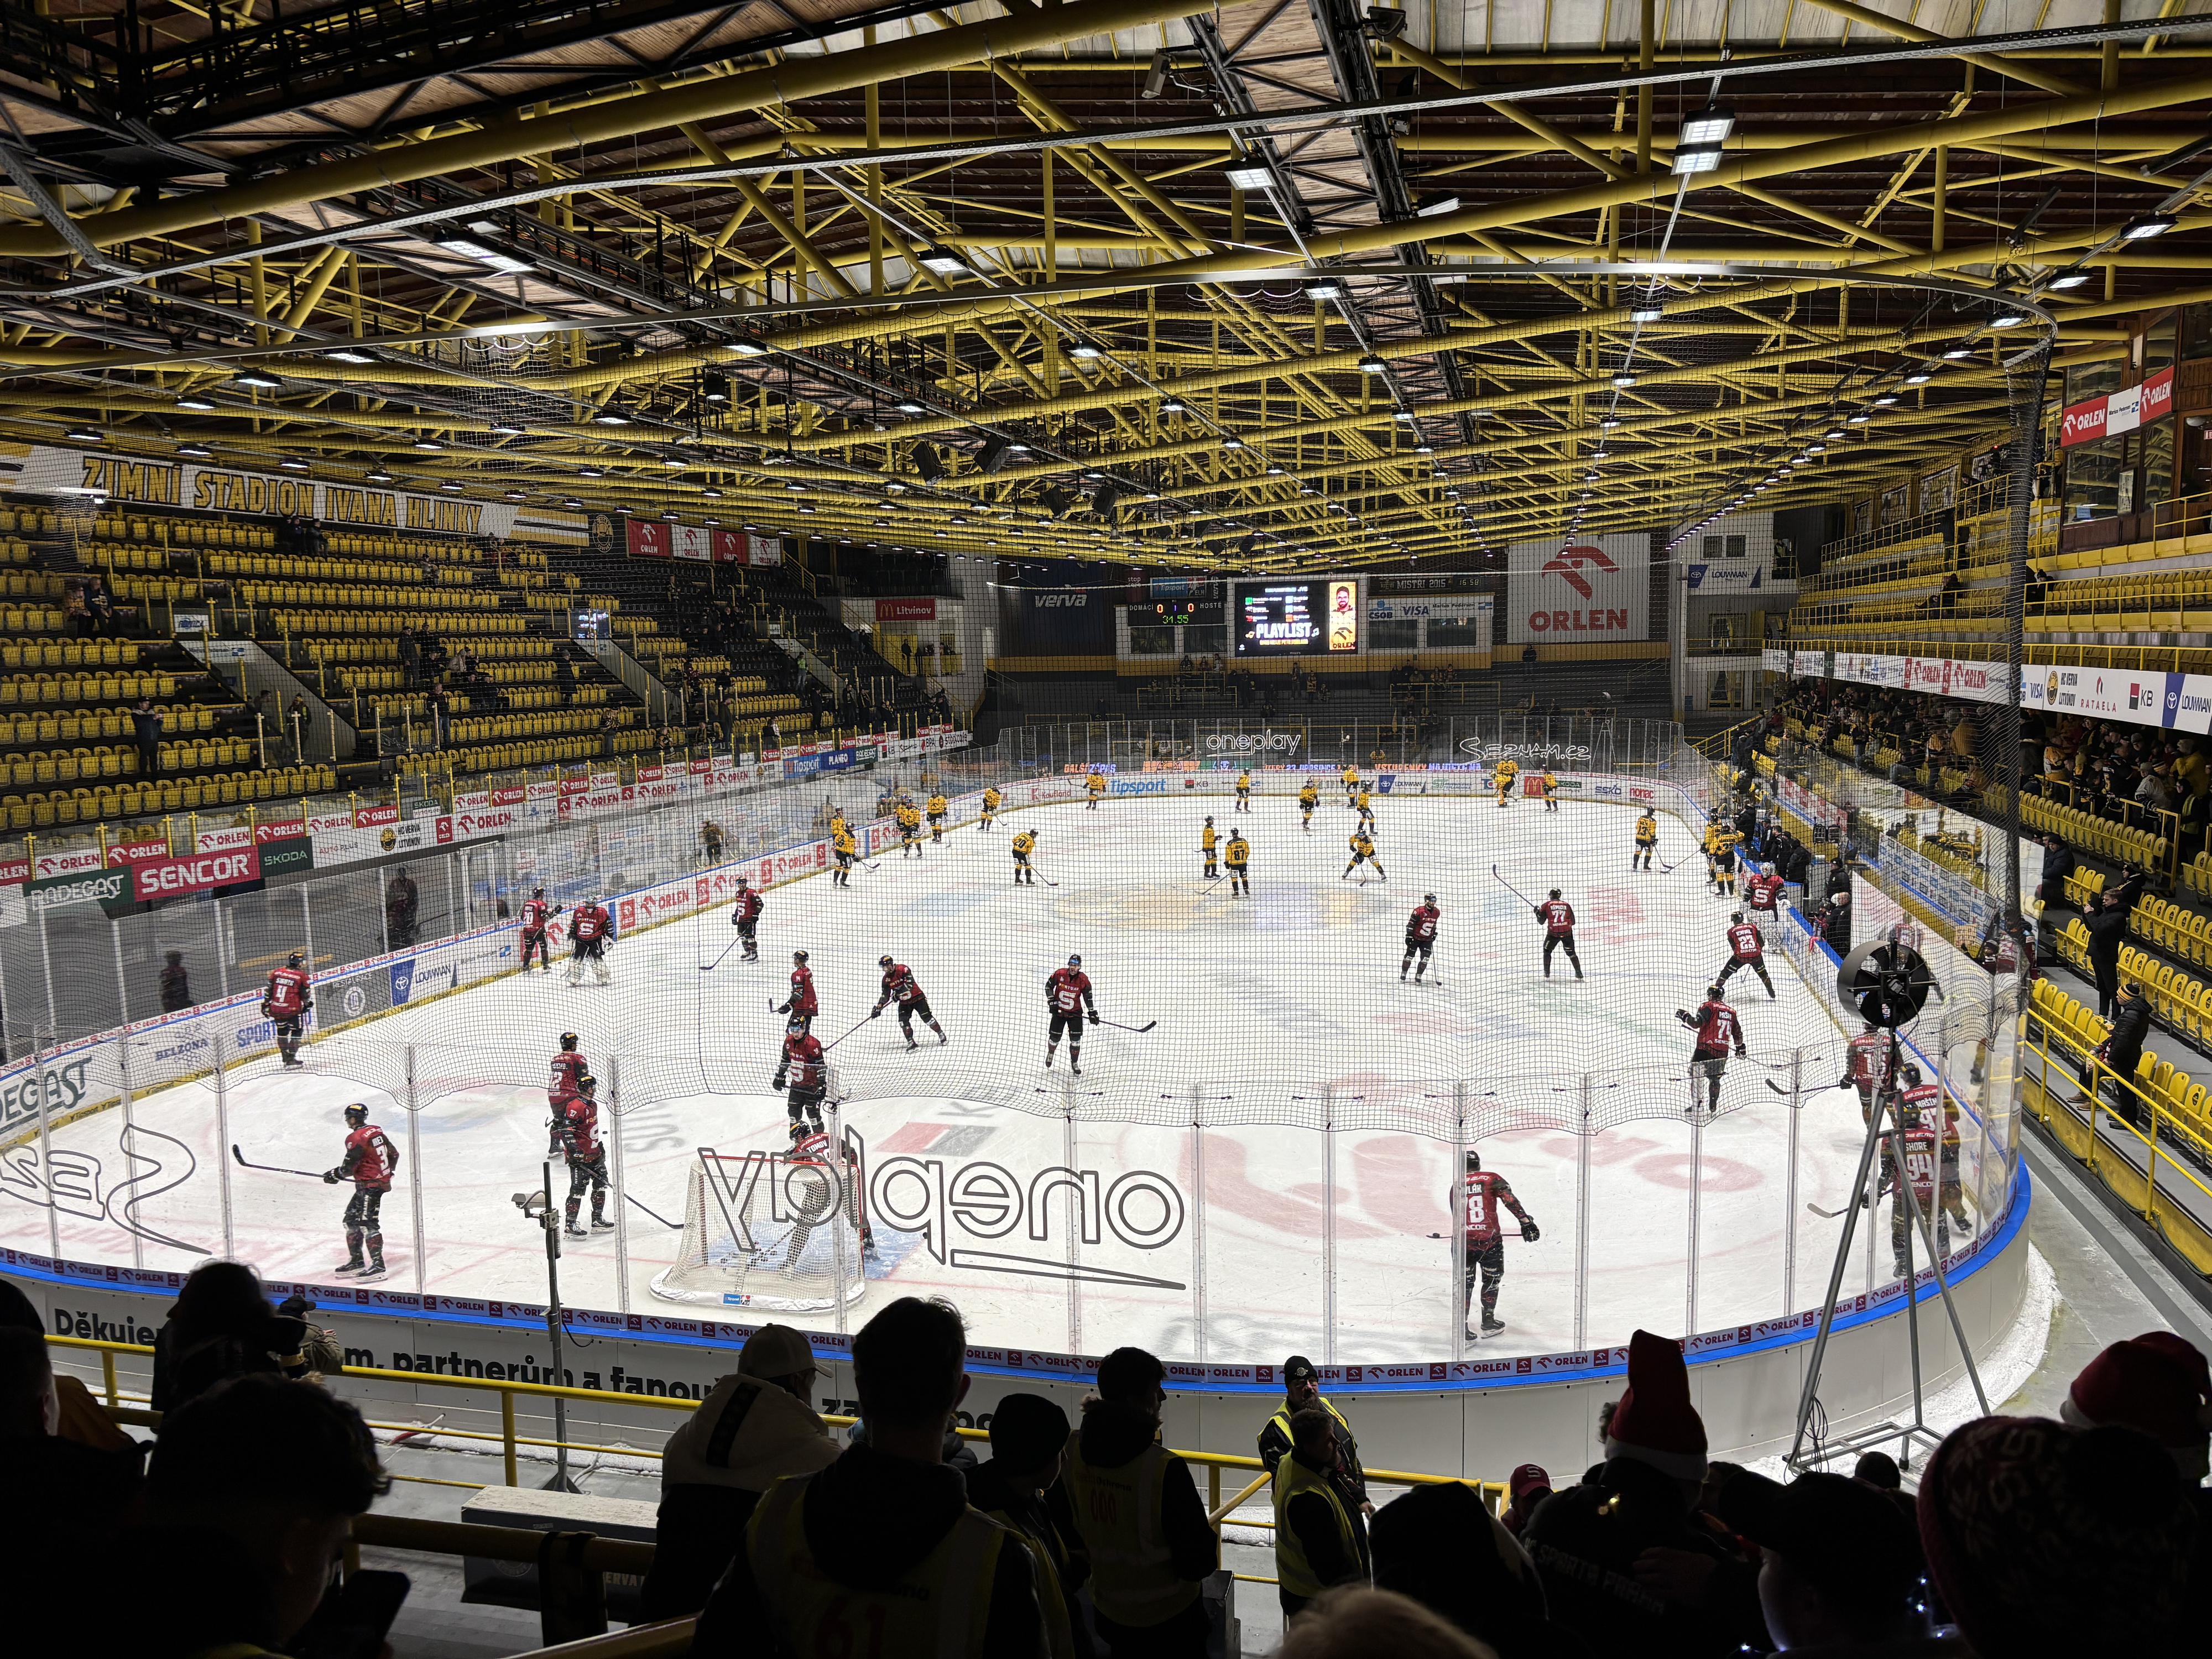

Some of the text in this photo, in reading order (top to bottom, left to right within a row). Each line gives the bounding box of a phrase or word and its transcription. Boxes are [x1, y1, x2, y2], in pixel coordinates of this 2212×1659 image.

[2150, 380, 2172, 405] ORLEN
[2077, 408, 2106, 430] ORLEN
[83, 457, 483, 533] ZIMNÍ STADION IVANA HLINKY
[640, 545, 658, 554] ORLEN
[1712, 570, 1747, 578] LOUWMAN
[1034, 593, 1088, 608] verva
[896, 606, 931, 615] Litvinov
[1156, 604, 1164, 613] 0
[1187, 603, 1194, 612] 0
[1401, 606, 1430, 615] VISA
[1528, 609, 1628, 632] ORLEN
[1256, 622, 1312, 639] PLAYLIST
[1332, 641, 1357, 649] ORLEN
[2030, 682, 2043, 700] VISA
[2140, 689, 2153, 707] KB
[2182, 694, 2211, 713] LOUWMAN
[2080, 698, 2117, 713] RATAELA
[1206, 728, 1301, 756] oneplay
[1109, 779, 1166, 796] Tipsport
[467, 795, 488, 806] ORLEN
[324, 815, 351, 829] ORLEN
[371, 809, 397, 822] ORLEN
[477, 812, 512, 829] ORLEN
[273, 823, 304, 837] ORLEN
[217, 831, 249, 845] ORLEN
[129, 843, 166, 858] ORLEN
[60, 853, 100, 870] ORLEN
[0, 864, 28, 880] RLEN
[140, 853, 250, 894] SENCOR
[659, 888, 689, 910] ORLEN
[415, 963, 451, 984] LOUWMAN
[806, 1139, 828, 1153] TOMOV
[1907, 1154, 1934, 1181] 94
[1468, 1195, 1485, 1223] 8
[1957, 1249, 1970, 1262] ORLEN
[29, 1258, 51, 1269] ORLEN
[79, 1266, 102, 1276] ORLEN
[135, 1272, 164, 1282] ORLEN
[1922, 1269, 1936, 1280] ORL
[268, 1284, 289, 1293] RLEN
[324, 1289, 351, 1300] ORLEN
[1880, 1284, 1901, 1298] ORLEN
[389, 1295, 419, 1306] ORLEN
[455, 1301, 484, 1312] ORLEN
[524, 1307, 545, 1318] ORL
[55, 1307, 157, 1346] Děkuje
[593, 1314, 622, 1326] ORLEN
[664, 1321, 697, 1332] ORLEN
[1771, 1317, 1799, 1332] ORLEN
[736, 1328, 757, 1338] ORL
[1704, 1332, 1734, 1345] ORLEN
[811, 1335, 846, 1347] ORLEN
[966, 1349, 1001, 1361] ORLEN
[1554, 1355, 1589, 1366] ORLEN
[1170, 1366, 1206, 1377] ORLEN
[1387, 1367, 1424, 1377] ORLEN
[1473, 1361, 1511, 1373] ORLEN
[1213, 1369, 1250, 1379] ORLEN
[1318, 1369, 1340, 1379] LEN
[609, 1366, 711, 1401] fanou
[1526, 1465, 1542, 1478] S
